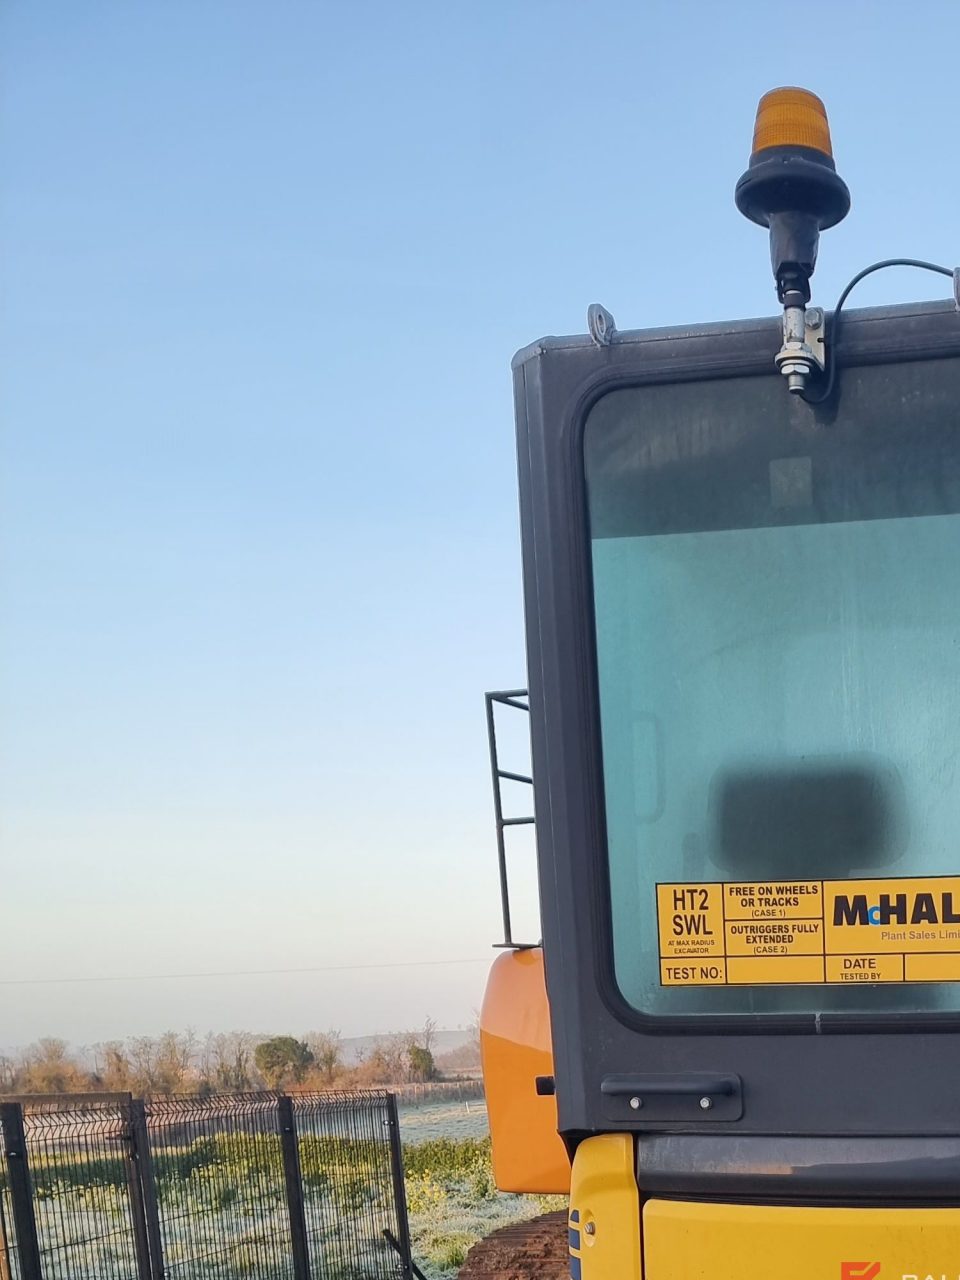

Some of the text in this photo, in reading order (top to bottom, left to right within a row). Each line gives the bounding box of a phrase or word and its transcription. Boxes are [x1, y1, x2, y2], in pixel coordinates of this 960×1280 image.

[729, 885, 818, 896] FREE ON WHEELS
[673, 889, 709, 911] HT2
[740, 897, 799, 908] OR TRACKS
[751, 909, 786, 918] (CASE 1)
[672, 914, 713, 936] SWL
[730, 924, 819, 935] OUTRIGGERS FULLY
[745, 934, 794, 944] EXTENDED
[881, 931, 906, 941] Plant
[909, 930, 936, 940] Sales
[753, 945, 788, 954] (CASE 2)
[843, 958, 877, 969] DATE
[666, 966, 723, 980] TEST NO:
